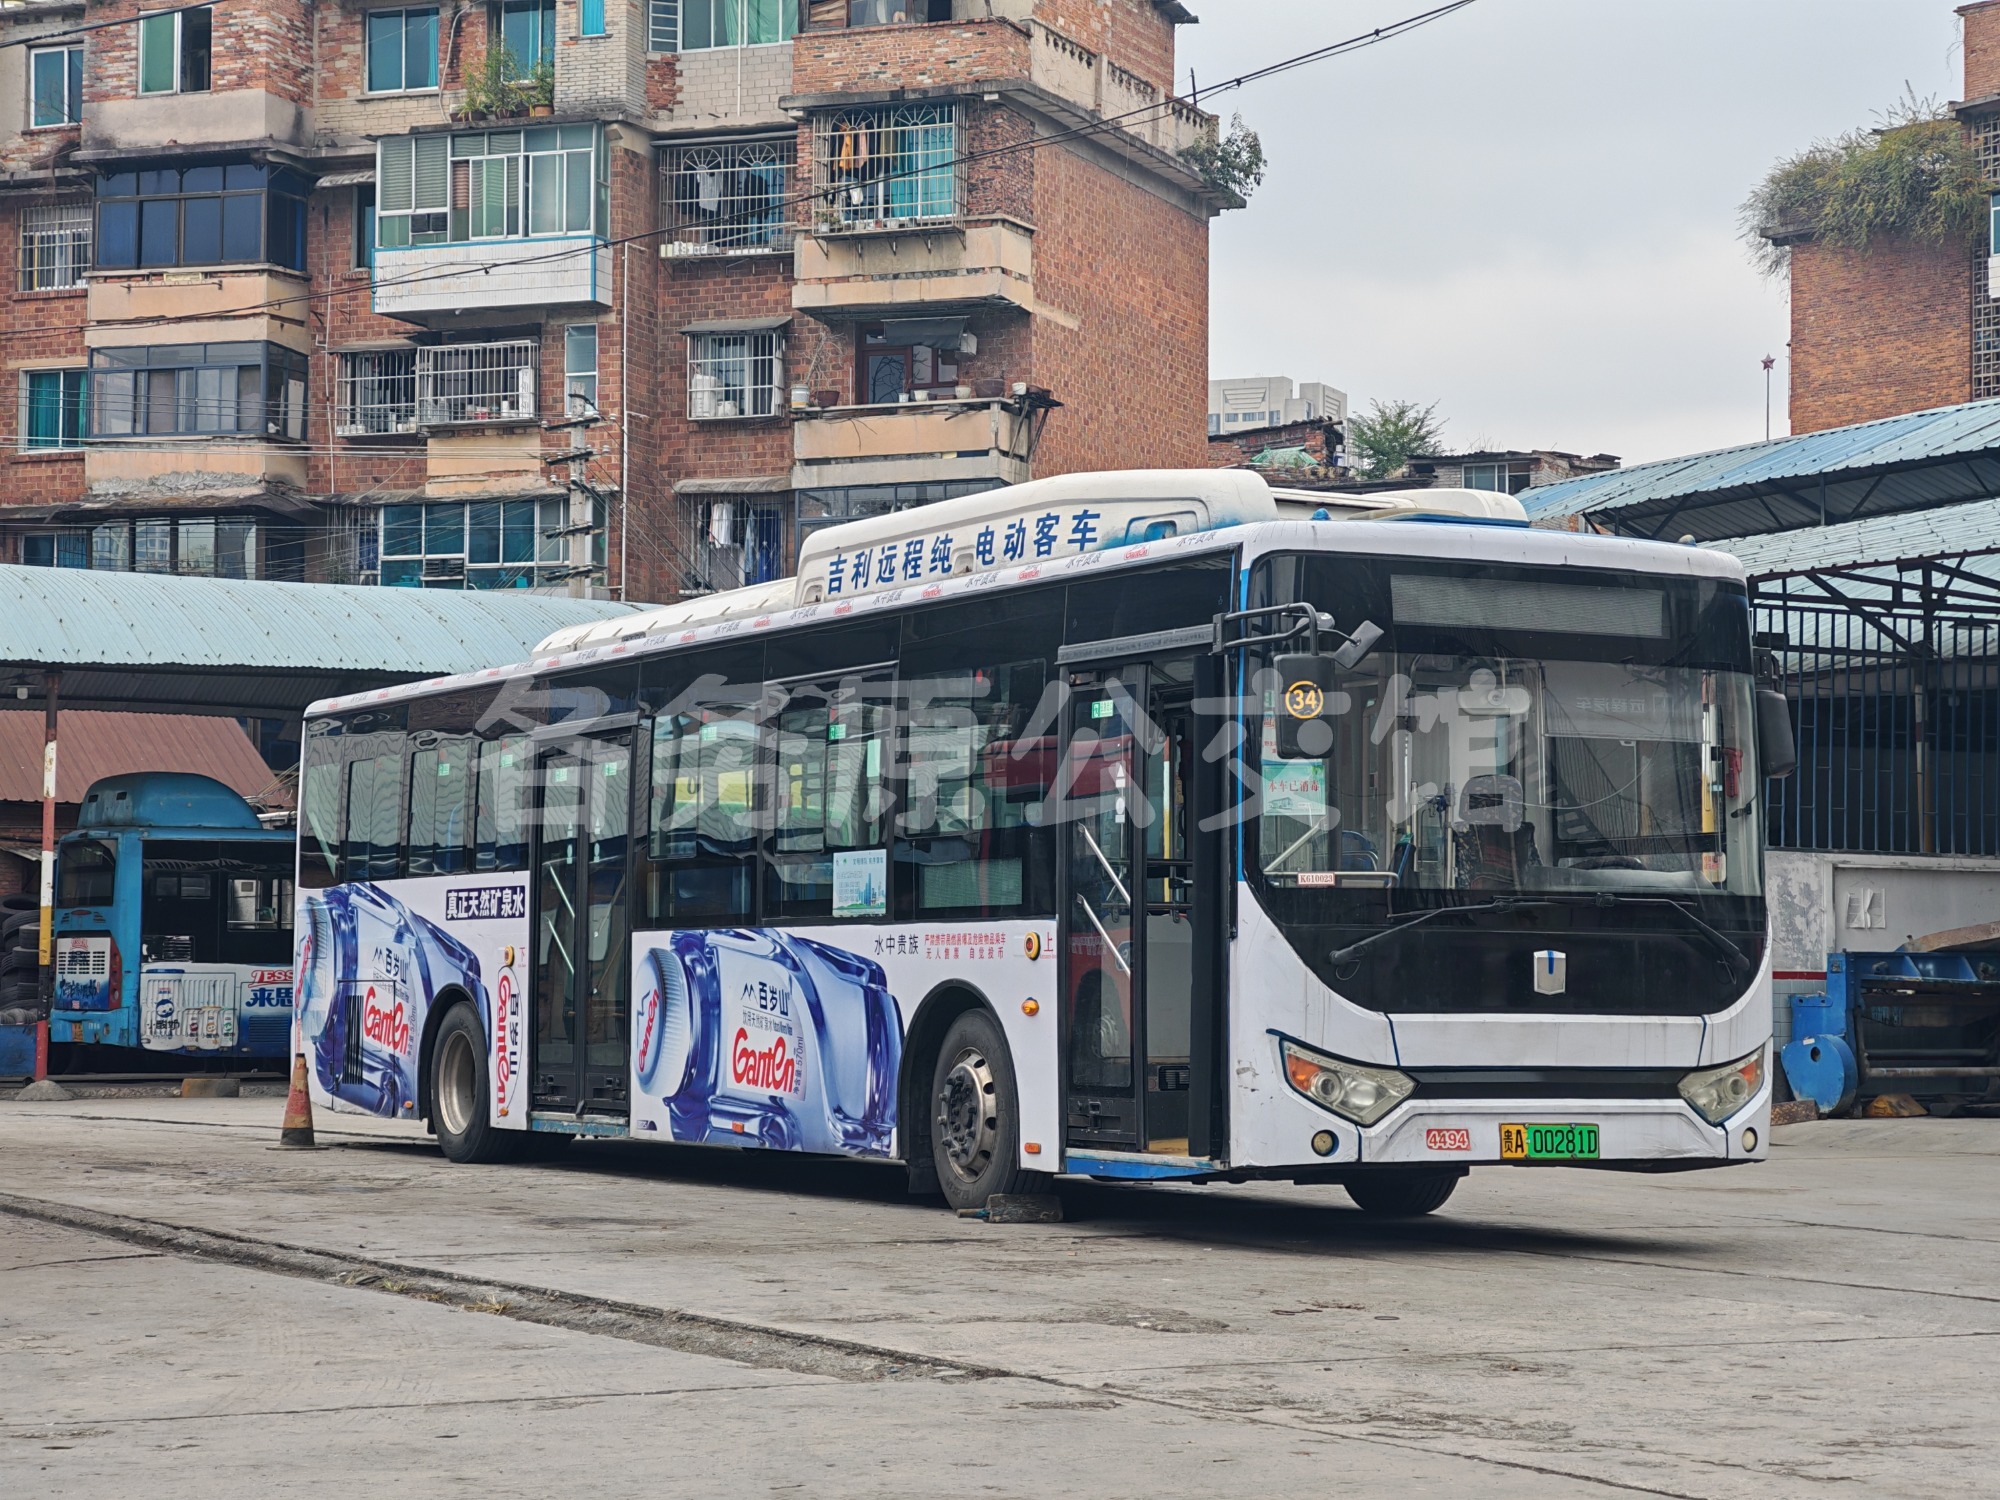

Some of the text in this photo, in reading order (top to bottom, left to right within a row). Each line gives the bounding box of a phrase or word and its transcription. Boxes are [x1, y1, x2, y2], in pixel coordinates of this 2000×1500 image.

[828, 509, 1101, 595] 吉利远程纯电动客车
[1292, 690, 1317, 710] 34
[1269, 780, 1319, 793] 本车已消毒
[446, 886, 524, 919] 真正天然矿泉水
[519, 947, 526, 962] 下
[874, 933, 919, 956] 水中贵族
[1043, 931, 1054, 953] 上
[385, 947, 408, 985] 百岁山
[758, 981, 790, 1017] 百岁山
[363, 986, 409, 1056] Ganten
[509, 992, 520, 1076] 百岁山
[497, 974, 511, 1104] Ganten
[732, 1027, 795, 1093] Ganten
[1427, 1129, 1470, 1150] 4494
